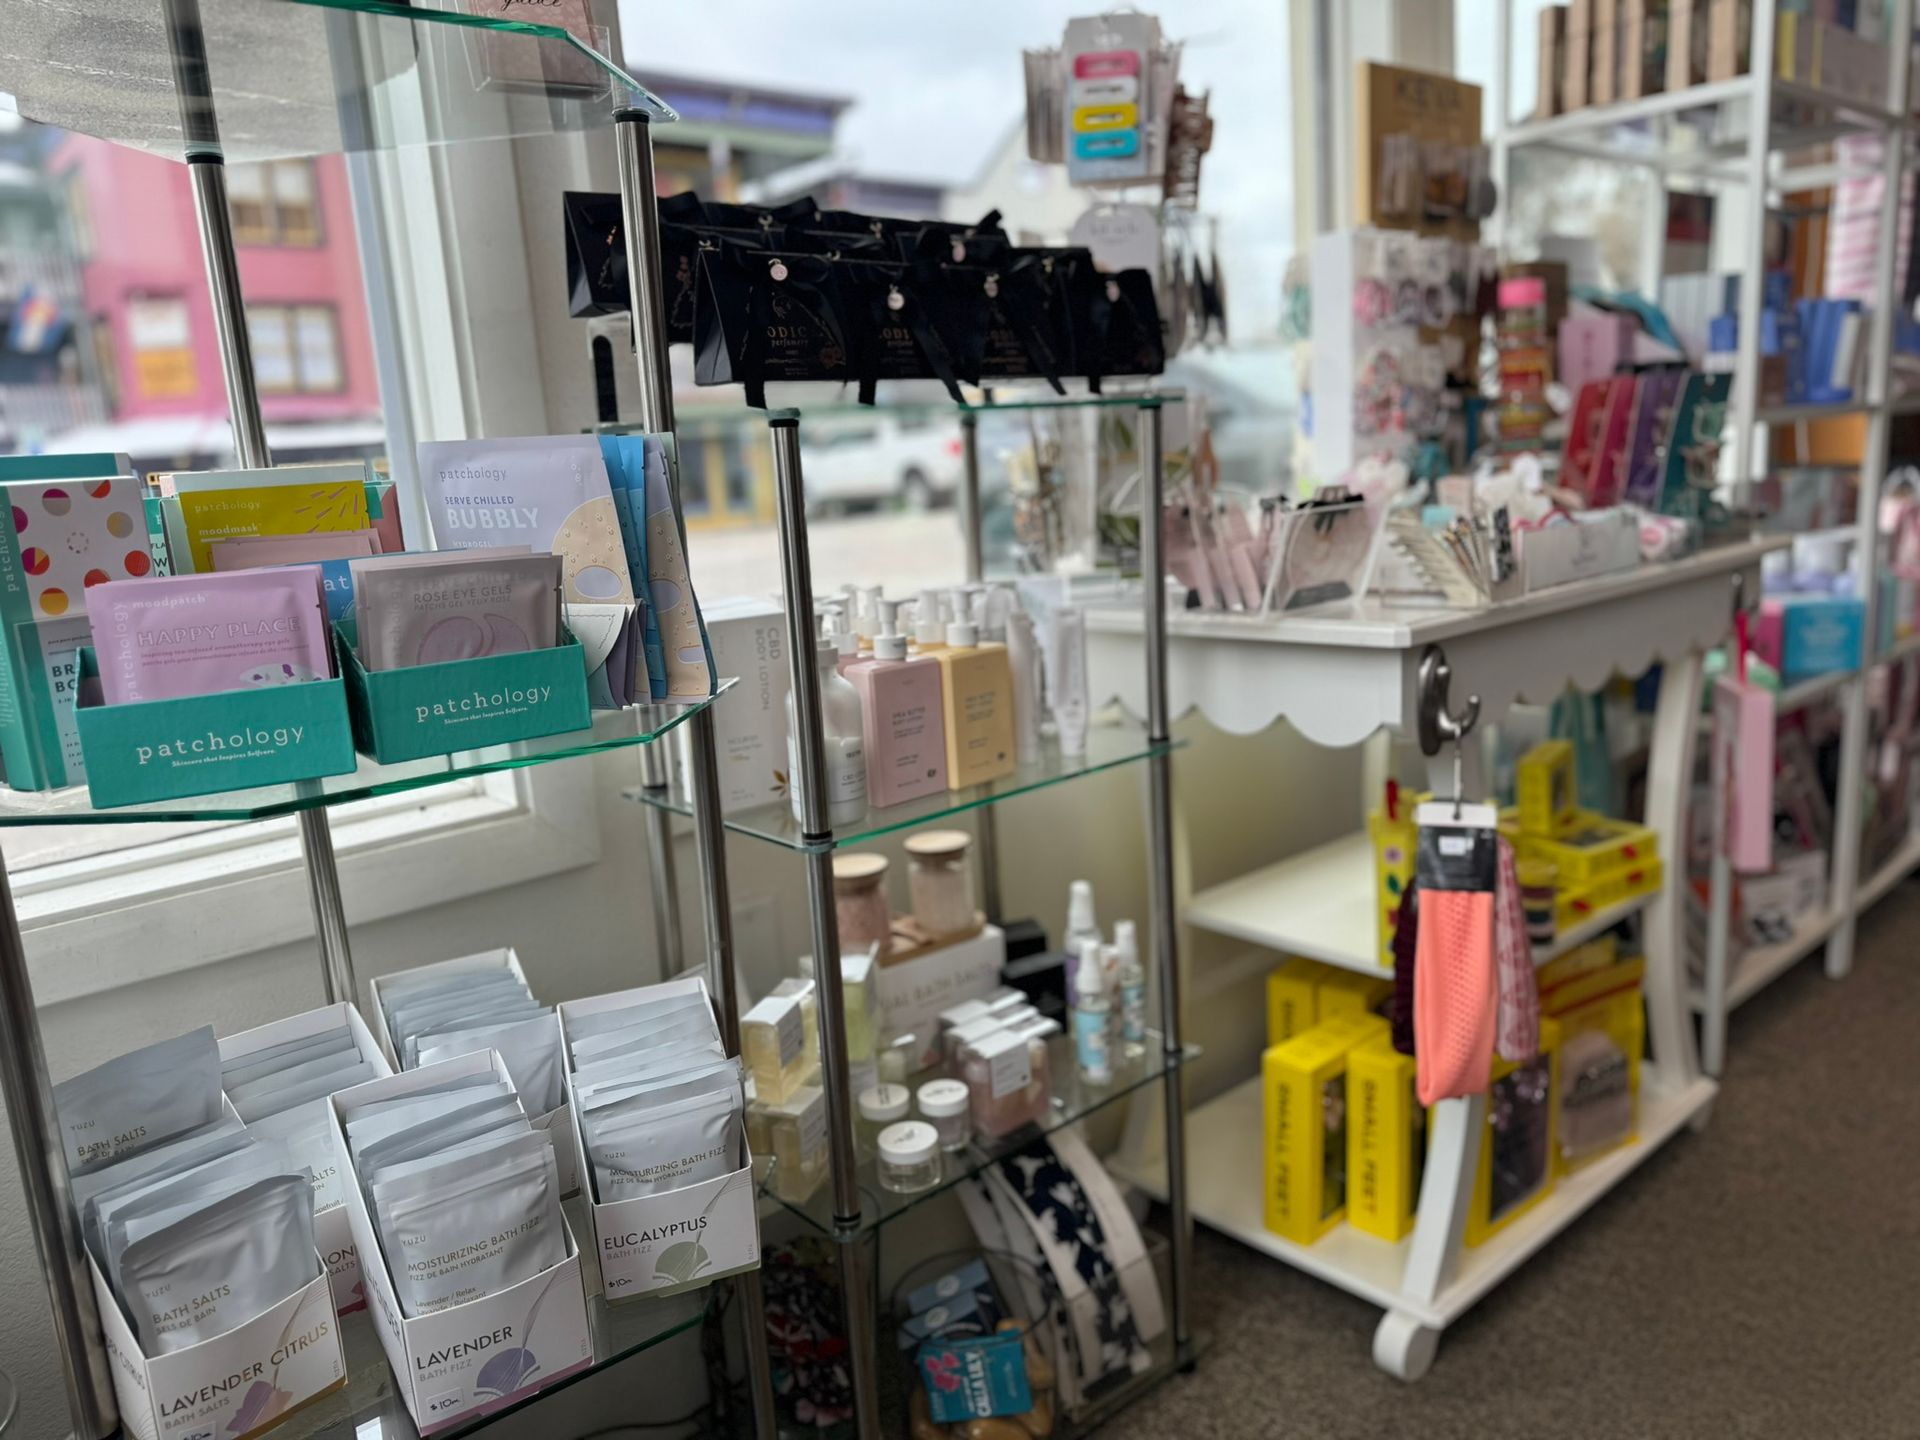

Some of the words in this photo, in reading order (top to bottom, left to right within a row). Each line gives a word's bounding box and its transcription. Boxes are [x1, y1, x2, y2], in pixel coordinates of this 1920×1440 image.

[439, 467, 507, 481] patchology
[194, 501, 261, 513] patchology
[445, 496, 471, 505] SERVE
[473, 495, 514, 505] CHILLED
[199, 523, 258, 536] moodmask
[447, 507, 539, 529] BUBBLY
[132, 595, 206, 609] moodpatch
[414, 590, 449, 603] ROSE
[453, 588, 477, 600] EYE
[481, 584, 512, 597] GELS
[137, 624, 220, 647] HAPPY
[227, 616, 300, 639] PLACE
[755, 628, 768, 661] BODY
[767, 627, 781, 660] CBD
[113, 602, 143, 700] patchology
[759, 665, 770, 711] LOTION
[415, 685, 551, 723] patchology
[136, 726, 303, 764] patchology
[77, 1139, 111, 1156] BATH
[114, 1126, 147, 1146] SALTS
[311, 1166, 336, 1183] ALTS
[609, 1160, 679, 1178] MOISTURIZING
[681, 1152, 707, 1167] BATH
[708, 1144, 727, 1158] FIZZ
[401, 1235, 427, 1247] YUZU
[407, 1240, 488, 1272] MOISTURIZING
[490, 1227, 518, 1246] BATH
[520, 1215, 542, 1233] FIZZ
[604, 1216, 707, 1250] EUCALYPTUS
[409, 1273, 425, 1281] FIZZ
[426, 1271, 437, 1280] DE
[439, 1264, 459, 1276] BAIN
[460, 1247, 505, 1268] HYDRATANT
[606, 1249, 631, 1260] BATH
[633, 1245, 652, 1256] FIZZ
[328, 1261, 355, 1277] SALTS
[152, 1304, 190, 1324] BATH
[192, 1284, 231, 1310] SALTS
[415, 1295, 450, 1307] Lavender
[456, 1286, 477, 1298] Relax
[155, 1323, 177, 1335] SELS
[179, 1319, 192, 1328] DE
[193, 1306, 217, 1323] BAIN
[416, 1326, 513, 1370] LAVENDER
[160, 1362, 263, 1417] LAVENDER
[270, 1321, 329, 1367] CITRUS
[419, 1368, 447, 1382] BATH
[450, 1358, 473, 1374] FIZZ
[165, 1412, 195, 1430] BATH
[199, 1396, 230, 1416] SALTS
